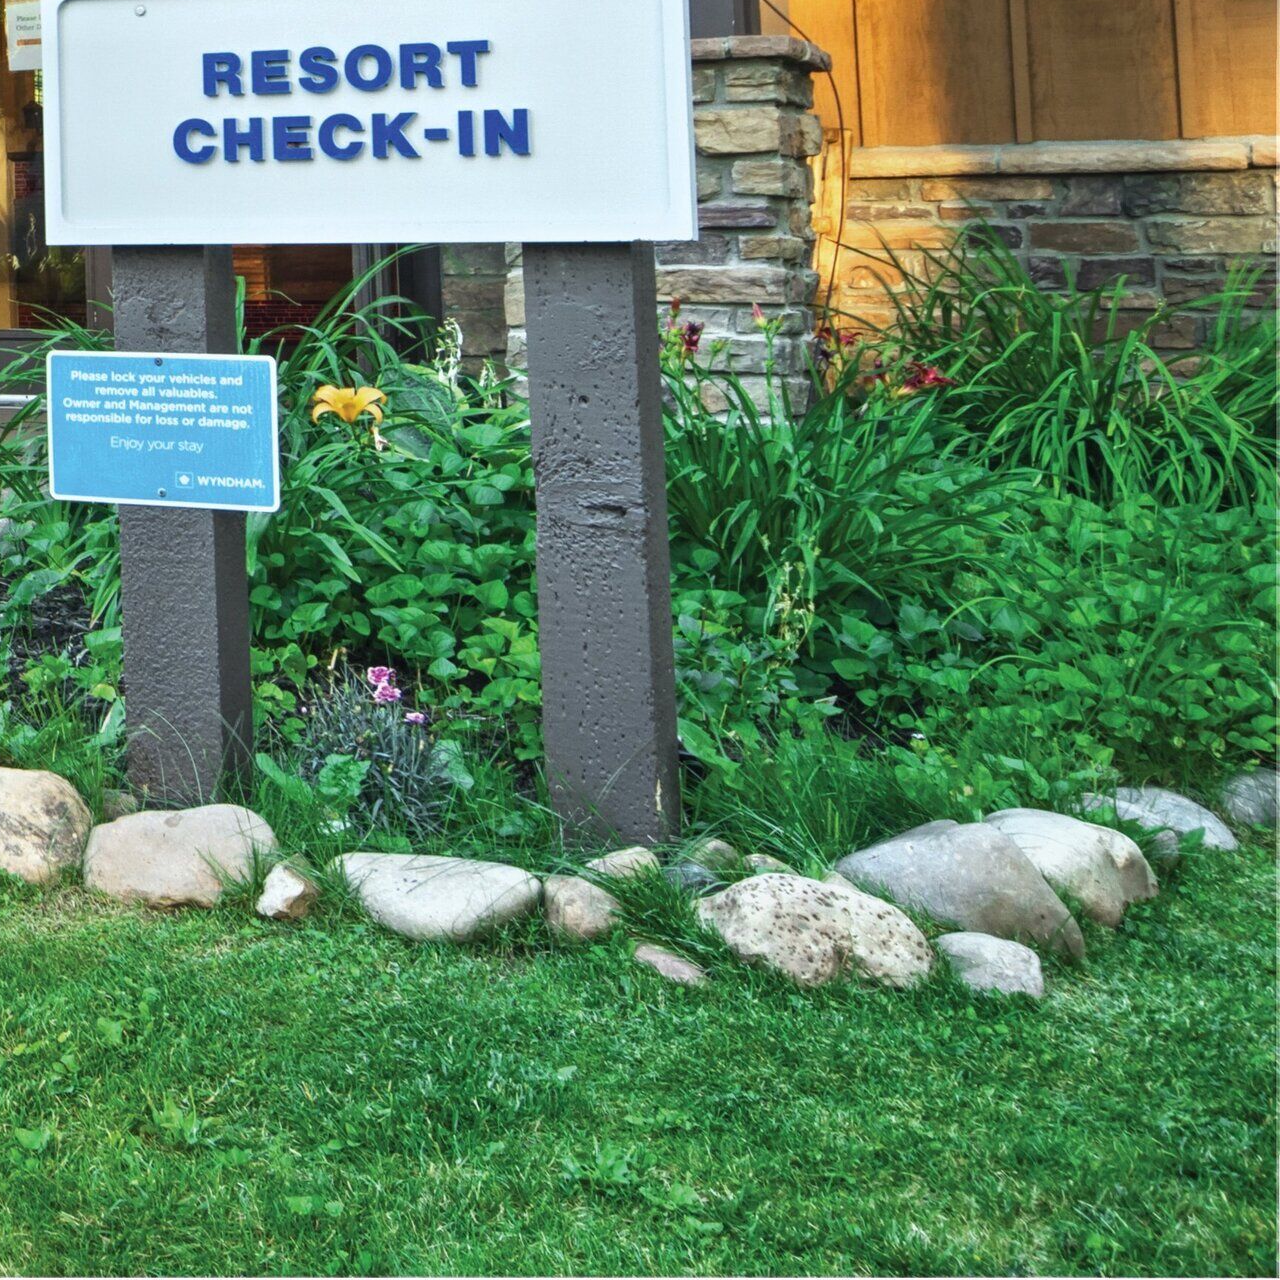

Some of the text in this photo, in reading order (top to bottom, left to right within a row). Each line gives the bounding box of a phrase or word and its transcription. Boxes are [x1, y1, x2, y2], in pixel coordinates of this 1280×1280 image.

[202, 39, 490, 98] RESORT
[172, 108, 531, 164] CHECK-IN
[70, 370, 243, 386] Please lock your vehicles and
[94, 386, 218, 400] remove all valuables.
[62, 397, 254, 415] Owner and Management are not
[65, 412, 251, 431] responsible for loss or damage.
[110, 435, 205, 454] Enjoy your stay
